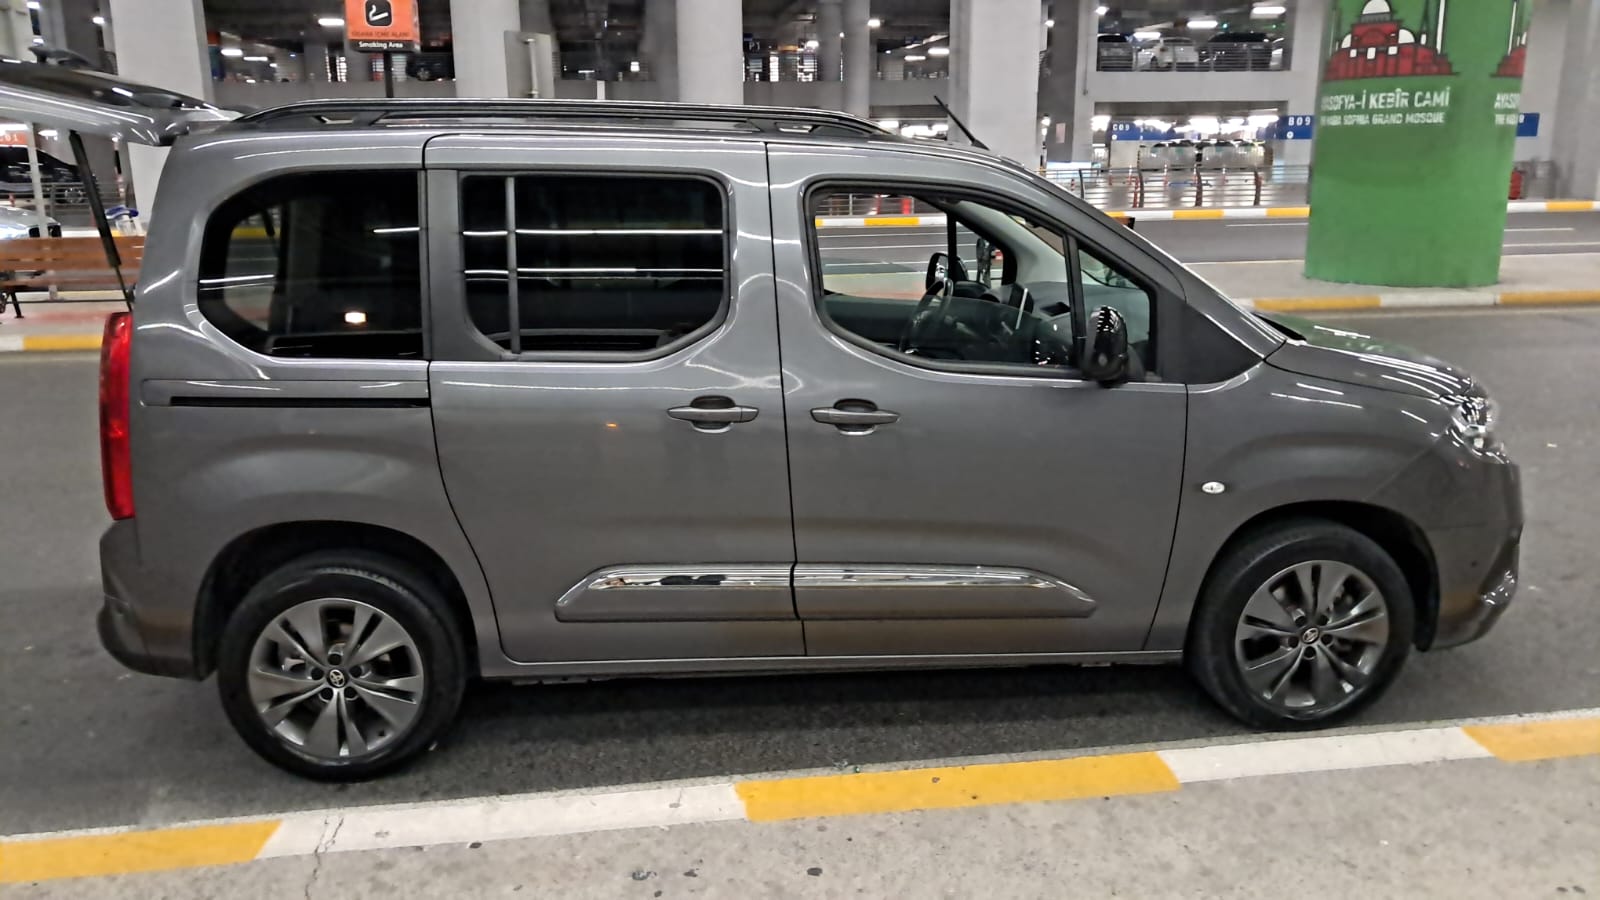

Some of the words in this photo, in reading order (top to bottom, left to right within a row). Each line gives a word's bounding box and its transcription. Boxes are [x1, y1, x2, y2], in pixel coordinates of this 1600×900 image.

[359, 41, 387, 49] Smoking
[1414, 84, 1451, 108] CAMİ
[1288, 116, 1311, 126] B09
[1371, 113, 1403, 125] GRAND
[1405, 112, 1445, 124] MOSQUE
